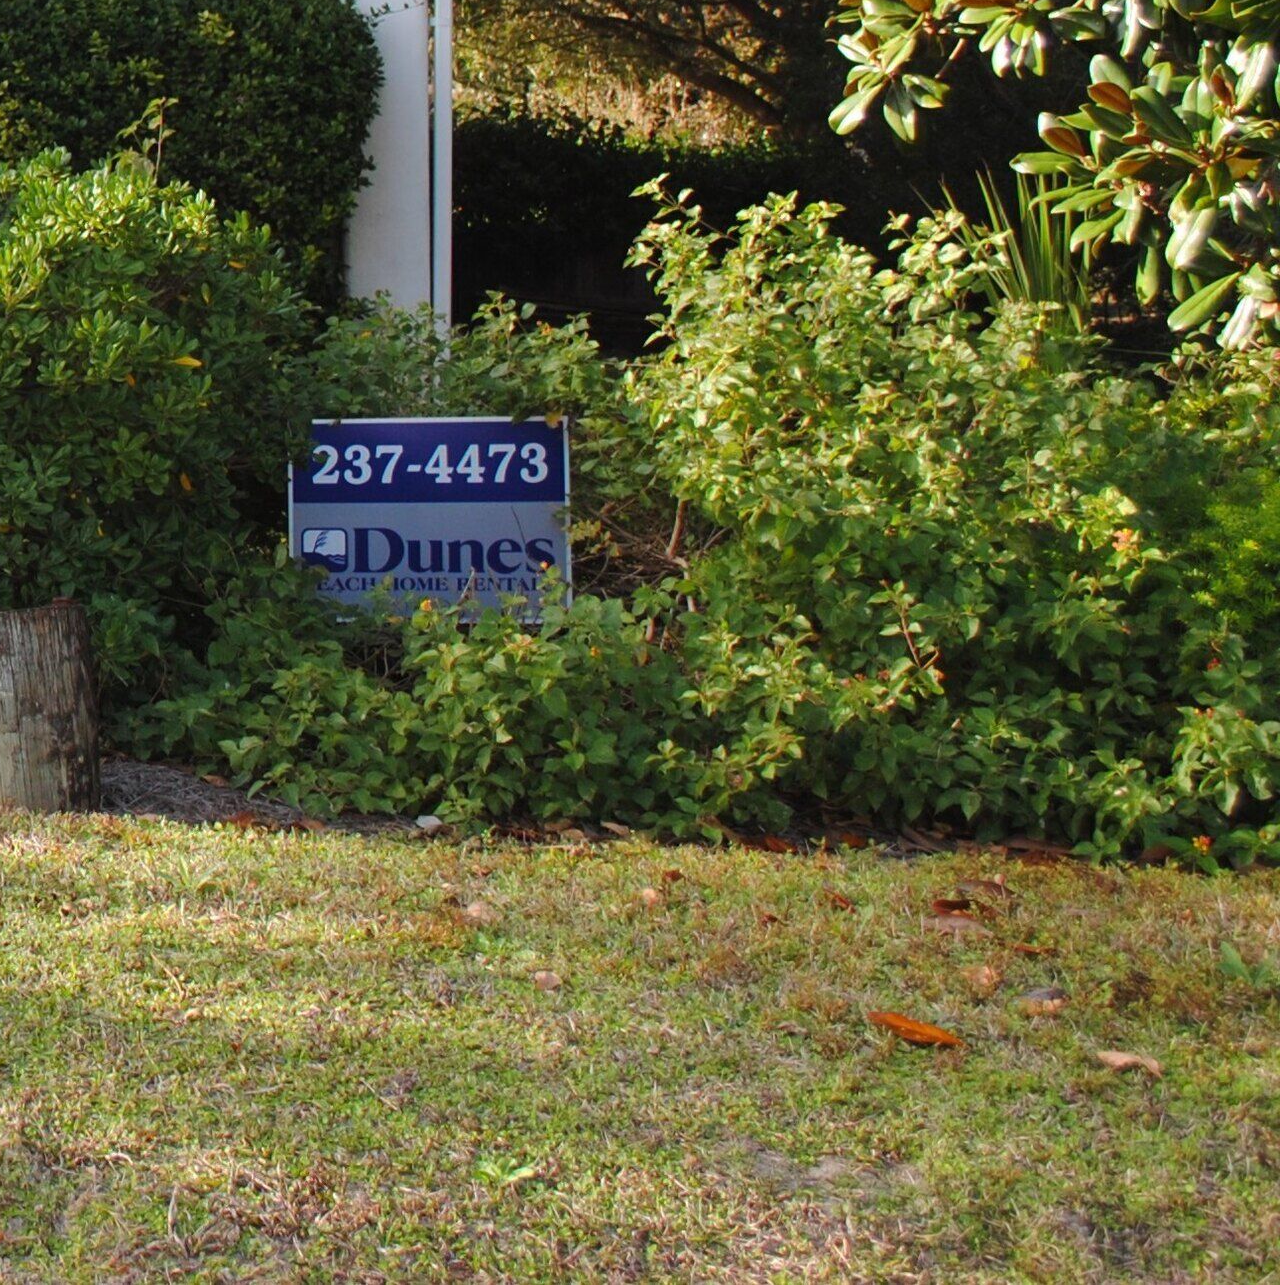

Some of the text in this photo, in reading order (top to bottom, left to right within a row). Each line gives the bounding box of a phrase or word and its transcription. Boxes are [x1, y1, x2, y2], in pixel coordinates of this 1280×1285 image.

[312, 443, 549, 485] 237-4473
[353, 527, 556, 574] Dunes
[317, 576, 376, 591] EACH
[457, 576, 539, 591] RENTAL
